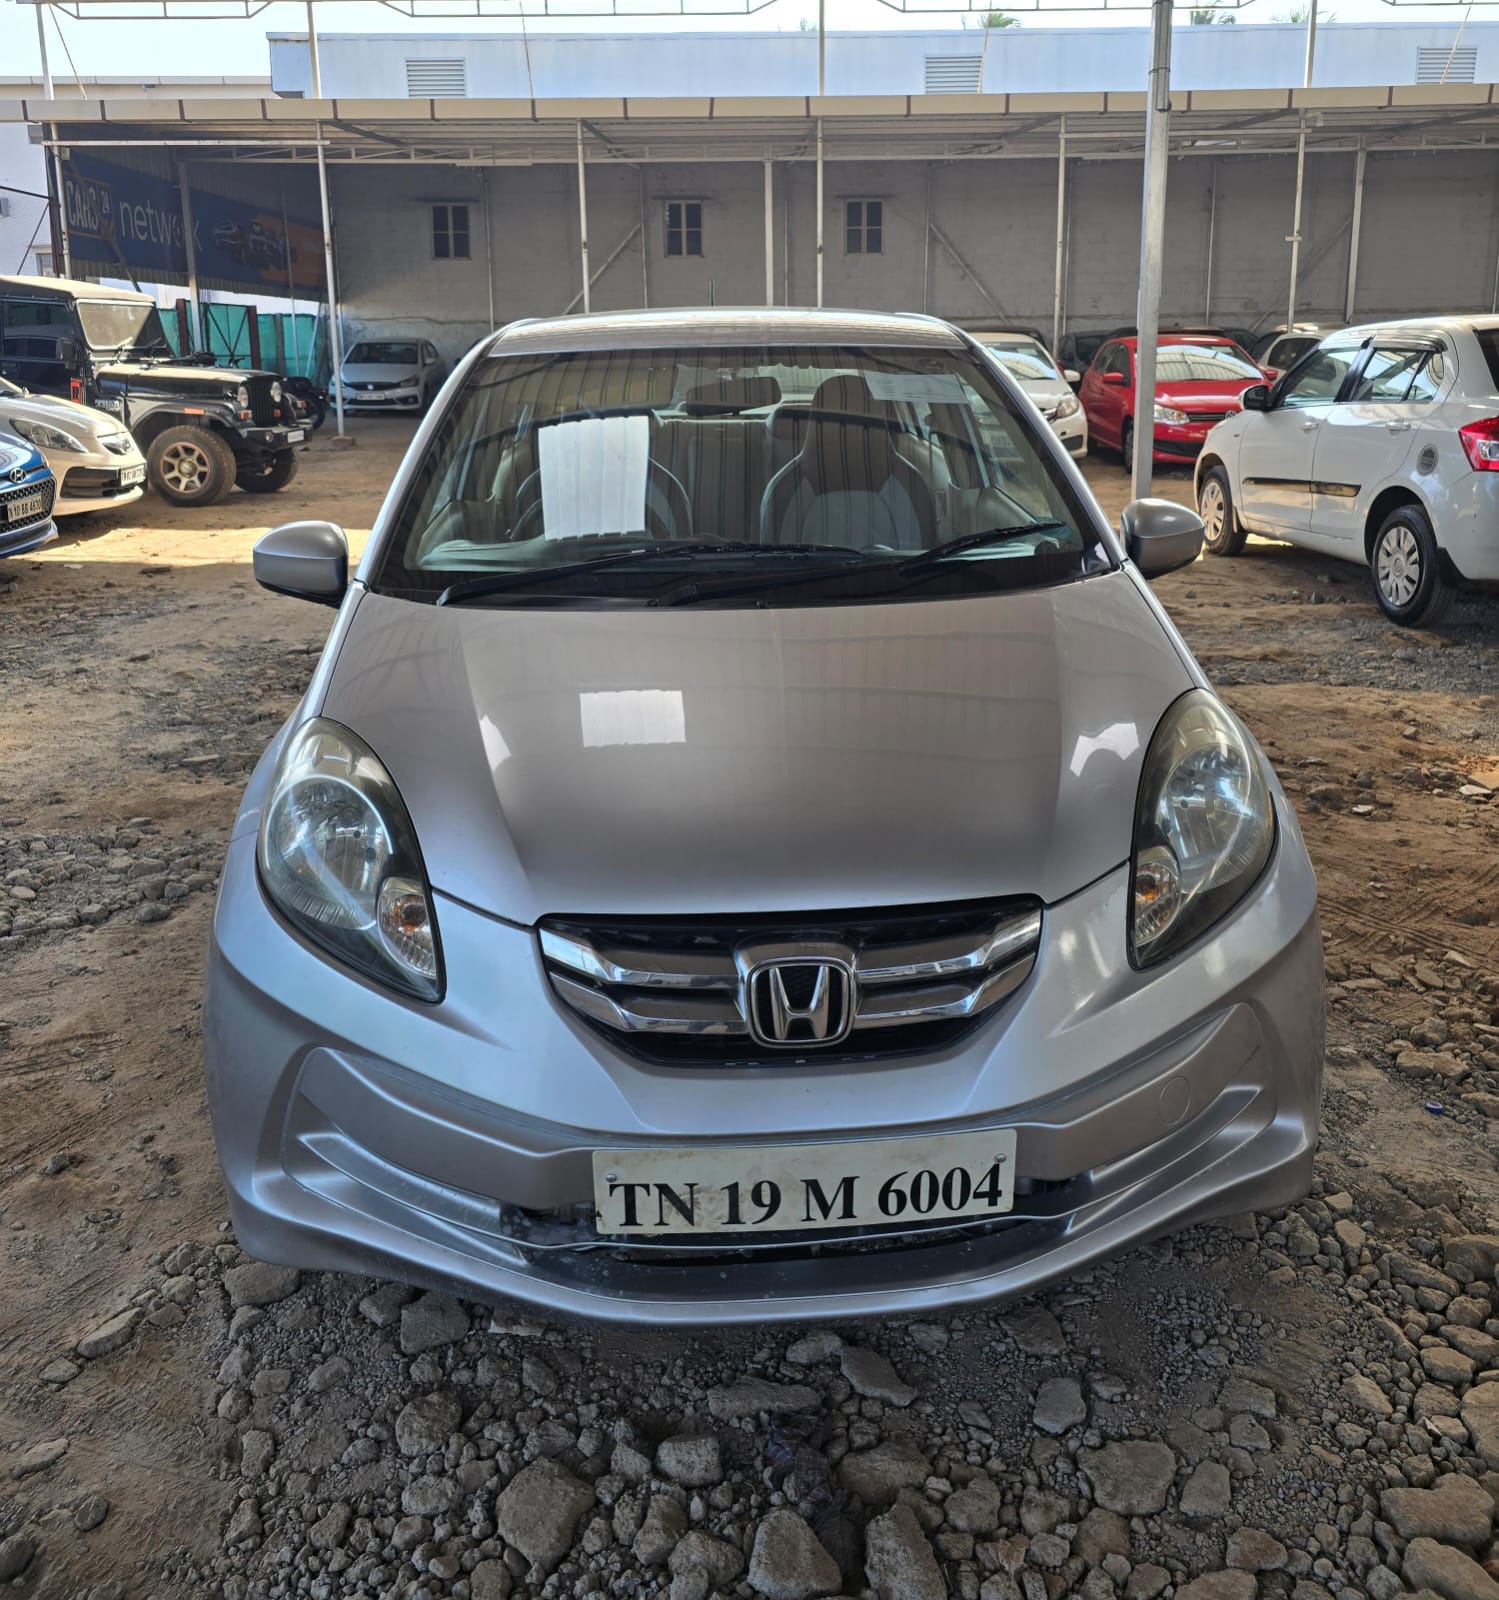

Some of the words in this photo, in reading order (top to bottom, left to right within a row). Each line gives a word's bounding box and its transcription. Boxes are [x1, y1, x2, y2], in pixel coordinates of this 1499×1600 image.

[65, 180, 99, 231] CARS
[100, 190, 110, 214] 24
[120, 200, 203, 250] netwok
[609, 1183, 699, 1226] TN
[720, 1180, 782, 1225] 19
[800, 1176, 861, 1222] M
[878, 1163, 1003, 1216] 6004
